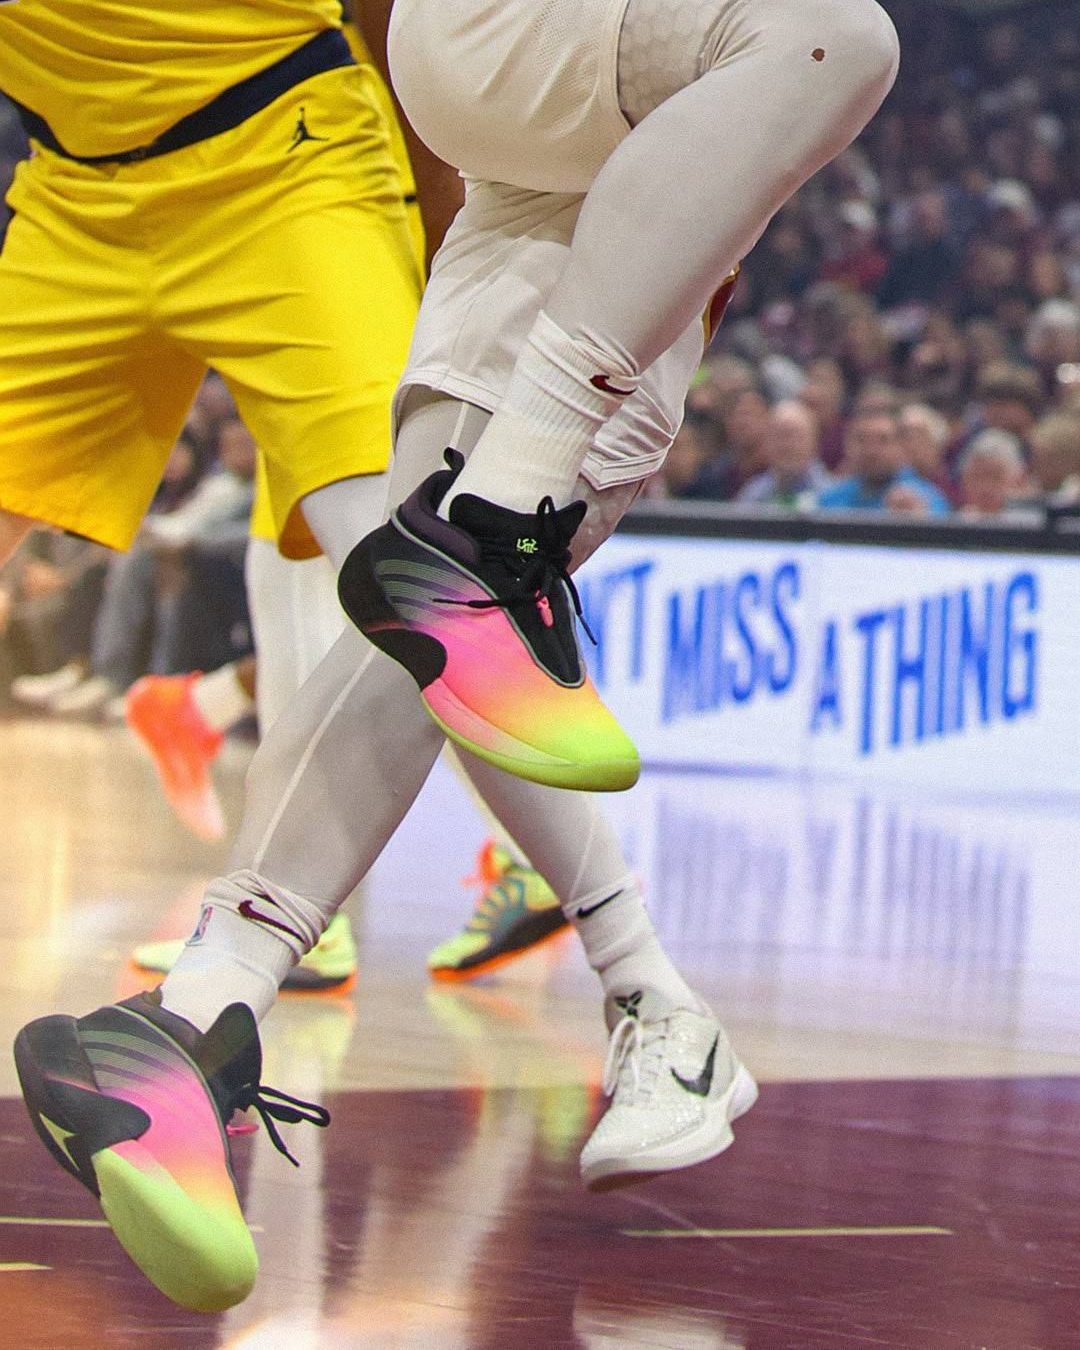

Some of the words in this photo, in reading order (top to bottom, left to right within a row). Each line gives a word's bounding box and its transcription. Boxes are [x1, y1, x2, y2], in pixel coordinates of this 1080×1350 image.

[660, 560, 800, 724] MISS
[809, 619, 843, 734] A
[855, 568, 1039, 758] THING
